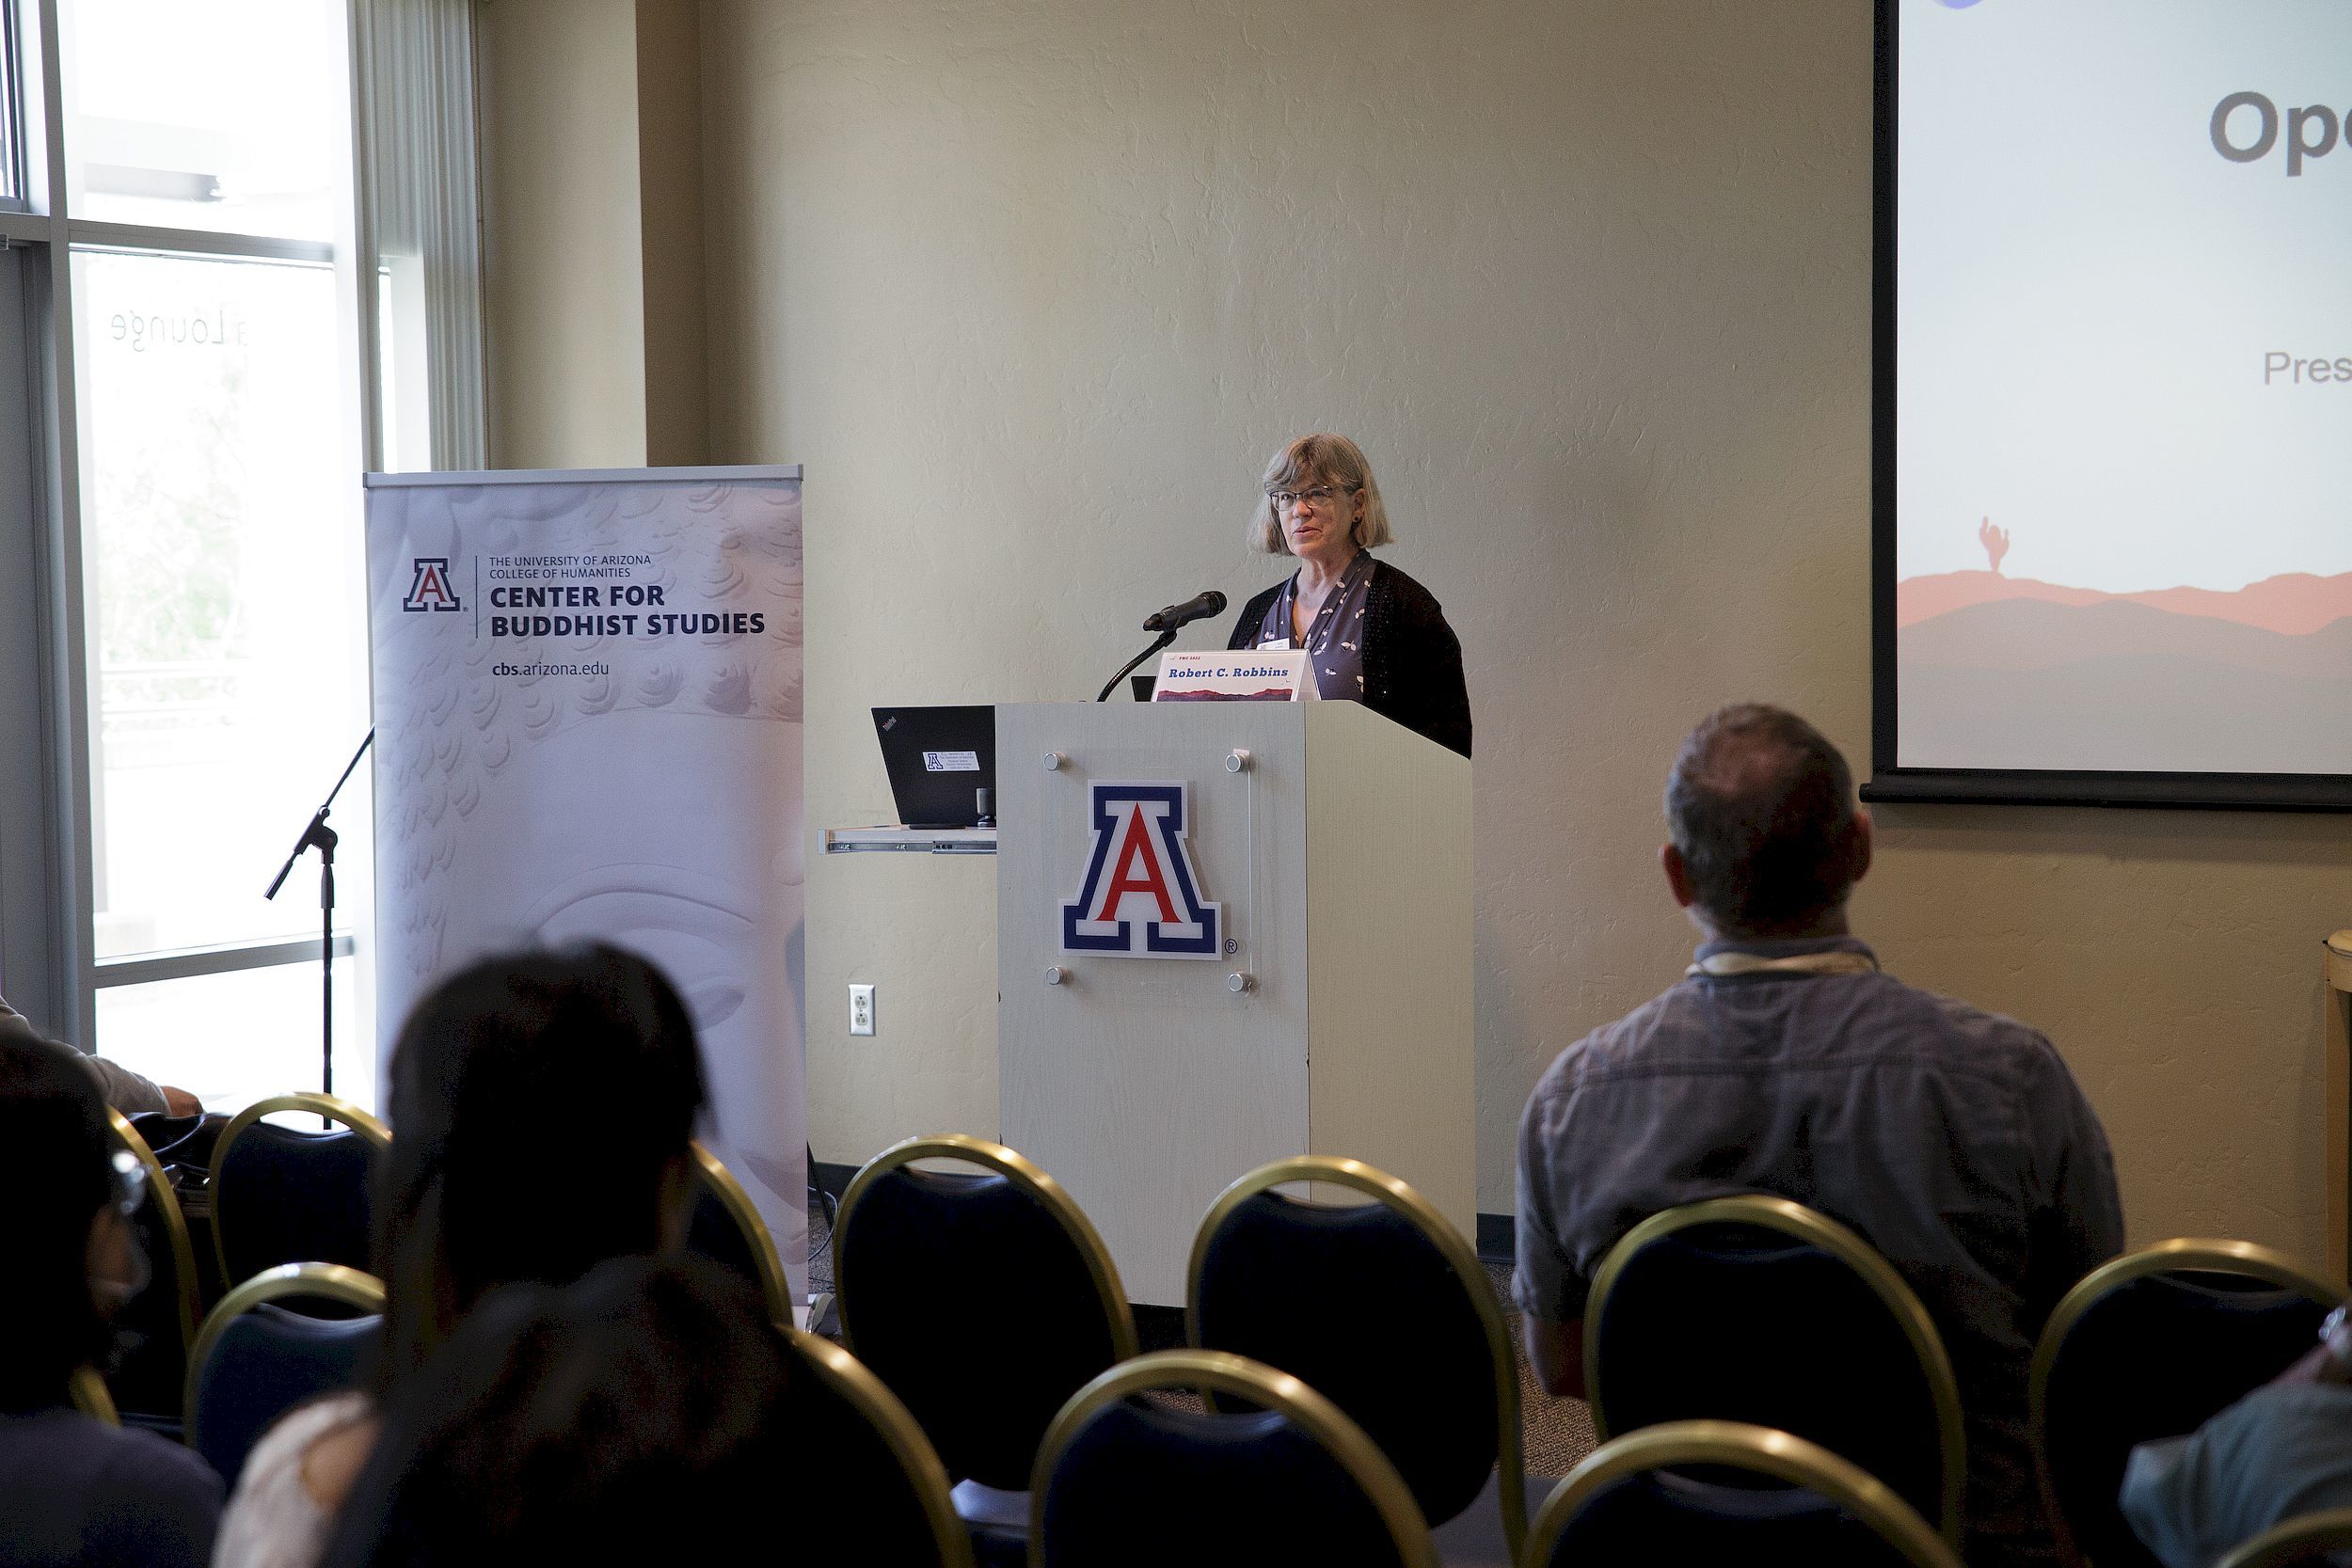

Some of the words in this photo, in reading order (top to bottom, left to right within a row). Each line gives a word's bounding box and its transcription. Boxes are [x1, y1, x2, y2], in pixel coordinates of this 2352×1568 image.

[2209, 90, 2352, 177] Op
[489, 557, 511, 567] THE
[514, 556, 580, 566] UNIVERSITY
[582, 555, 597, 565] OF
[600, 555, 652, 565] ARIZONA
[489, 569, 539, 579] COLLEGE
[542, 569, 558, 579] OF
[561, 568, 630, 578] HUMANITIES
[490, 586, 600, 608] CENTER
[611, 585, 664, 607] FOR
[492, 614, 639, 637] BUDDHIST
[647, 612, 765, 635] STUDIES
[492, 661, 610, 676] cbs.arizona.edu
[1168, 668, 1213, 678] Robert
[1216, 668, 1229, 678] C.
[1232, 667, 1289, 677] Robbins
